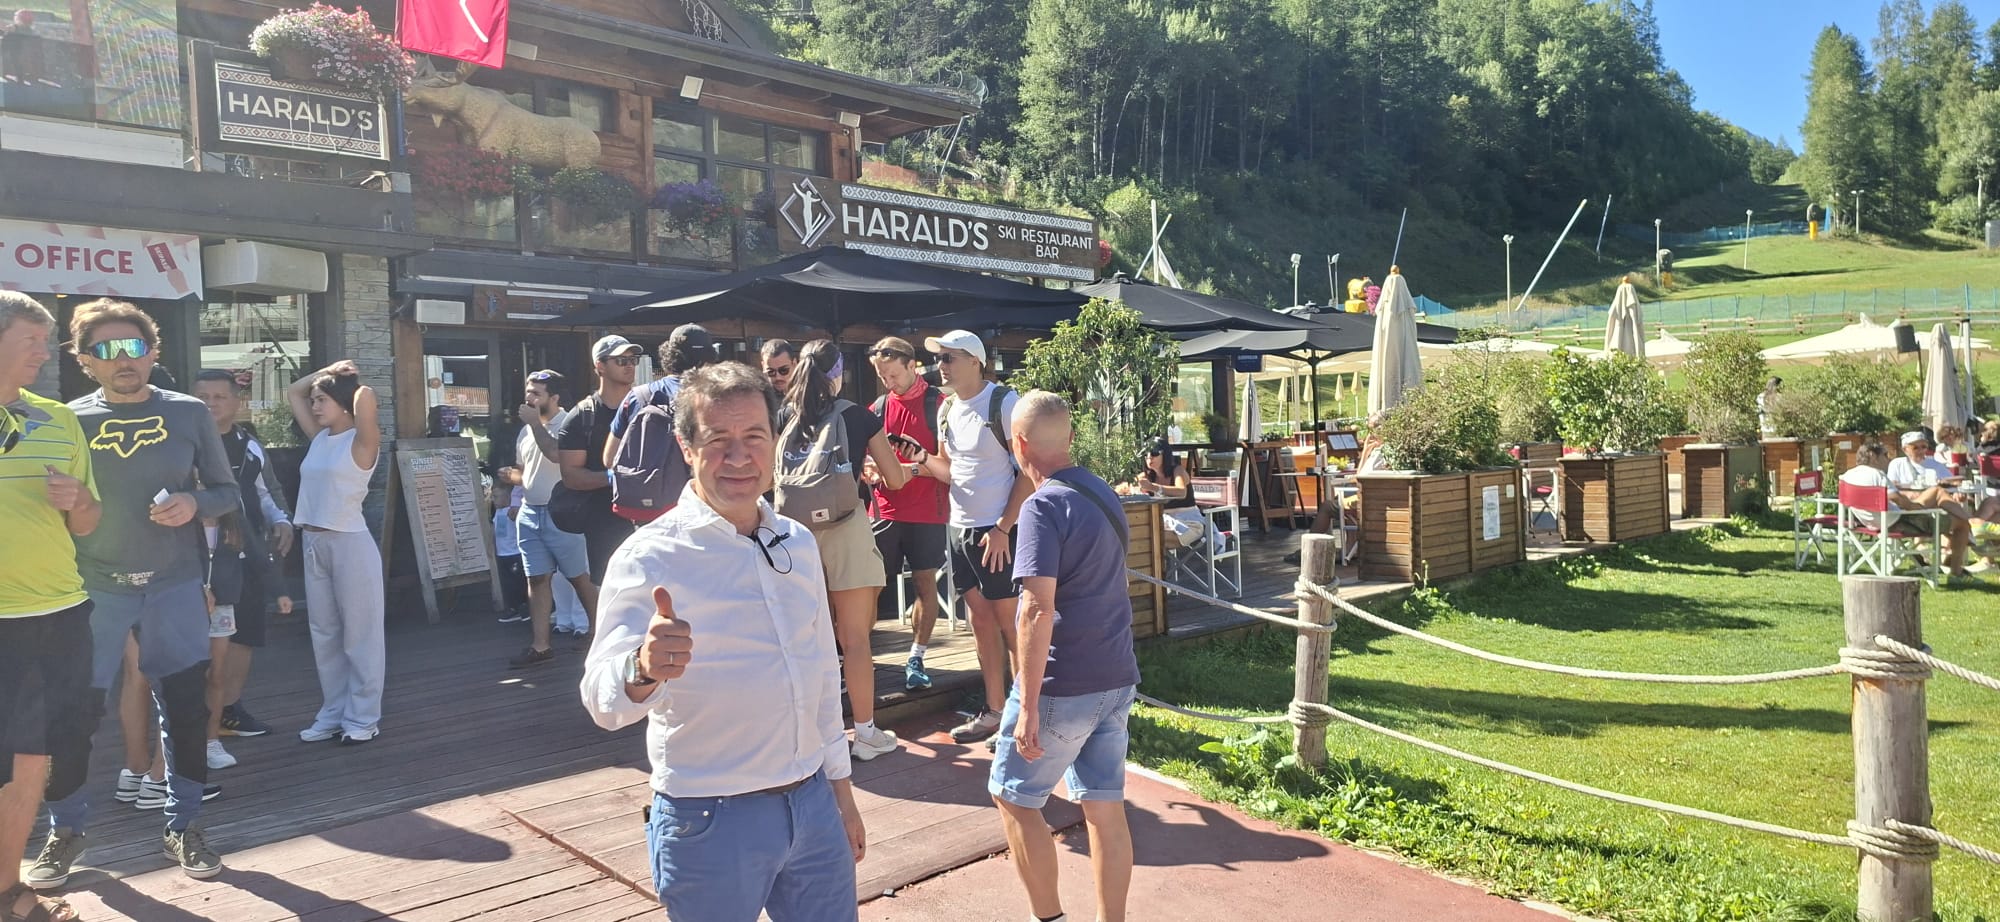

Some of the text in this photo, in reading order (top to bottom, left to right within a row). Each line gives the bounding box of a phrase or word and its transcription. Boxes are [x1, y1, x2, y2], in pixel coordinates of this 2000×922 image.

[228, 91, 373, 131] HARALD'S
[842, 203, 989, 250] HARALD'S
[998, 226, 1093, 250] SKI RESTAURANT
[15, 243, 134, 274] OFFICE
[1036, 244, 1059, 259] BAR
